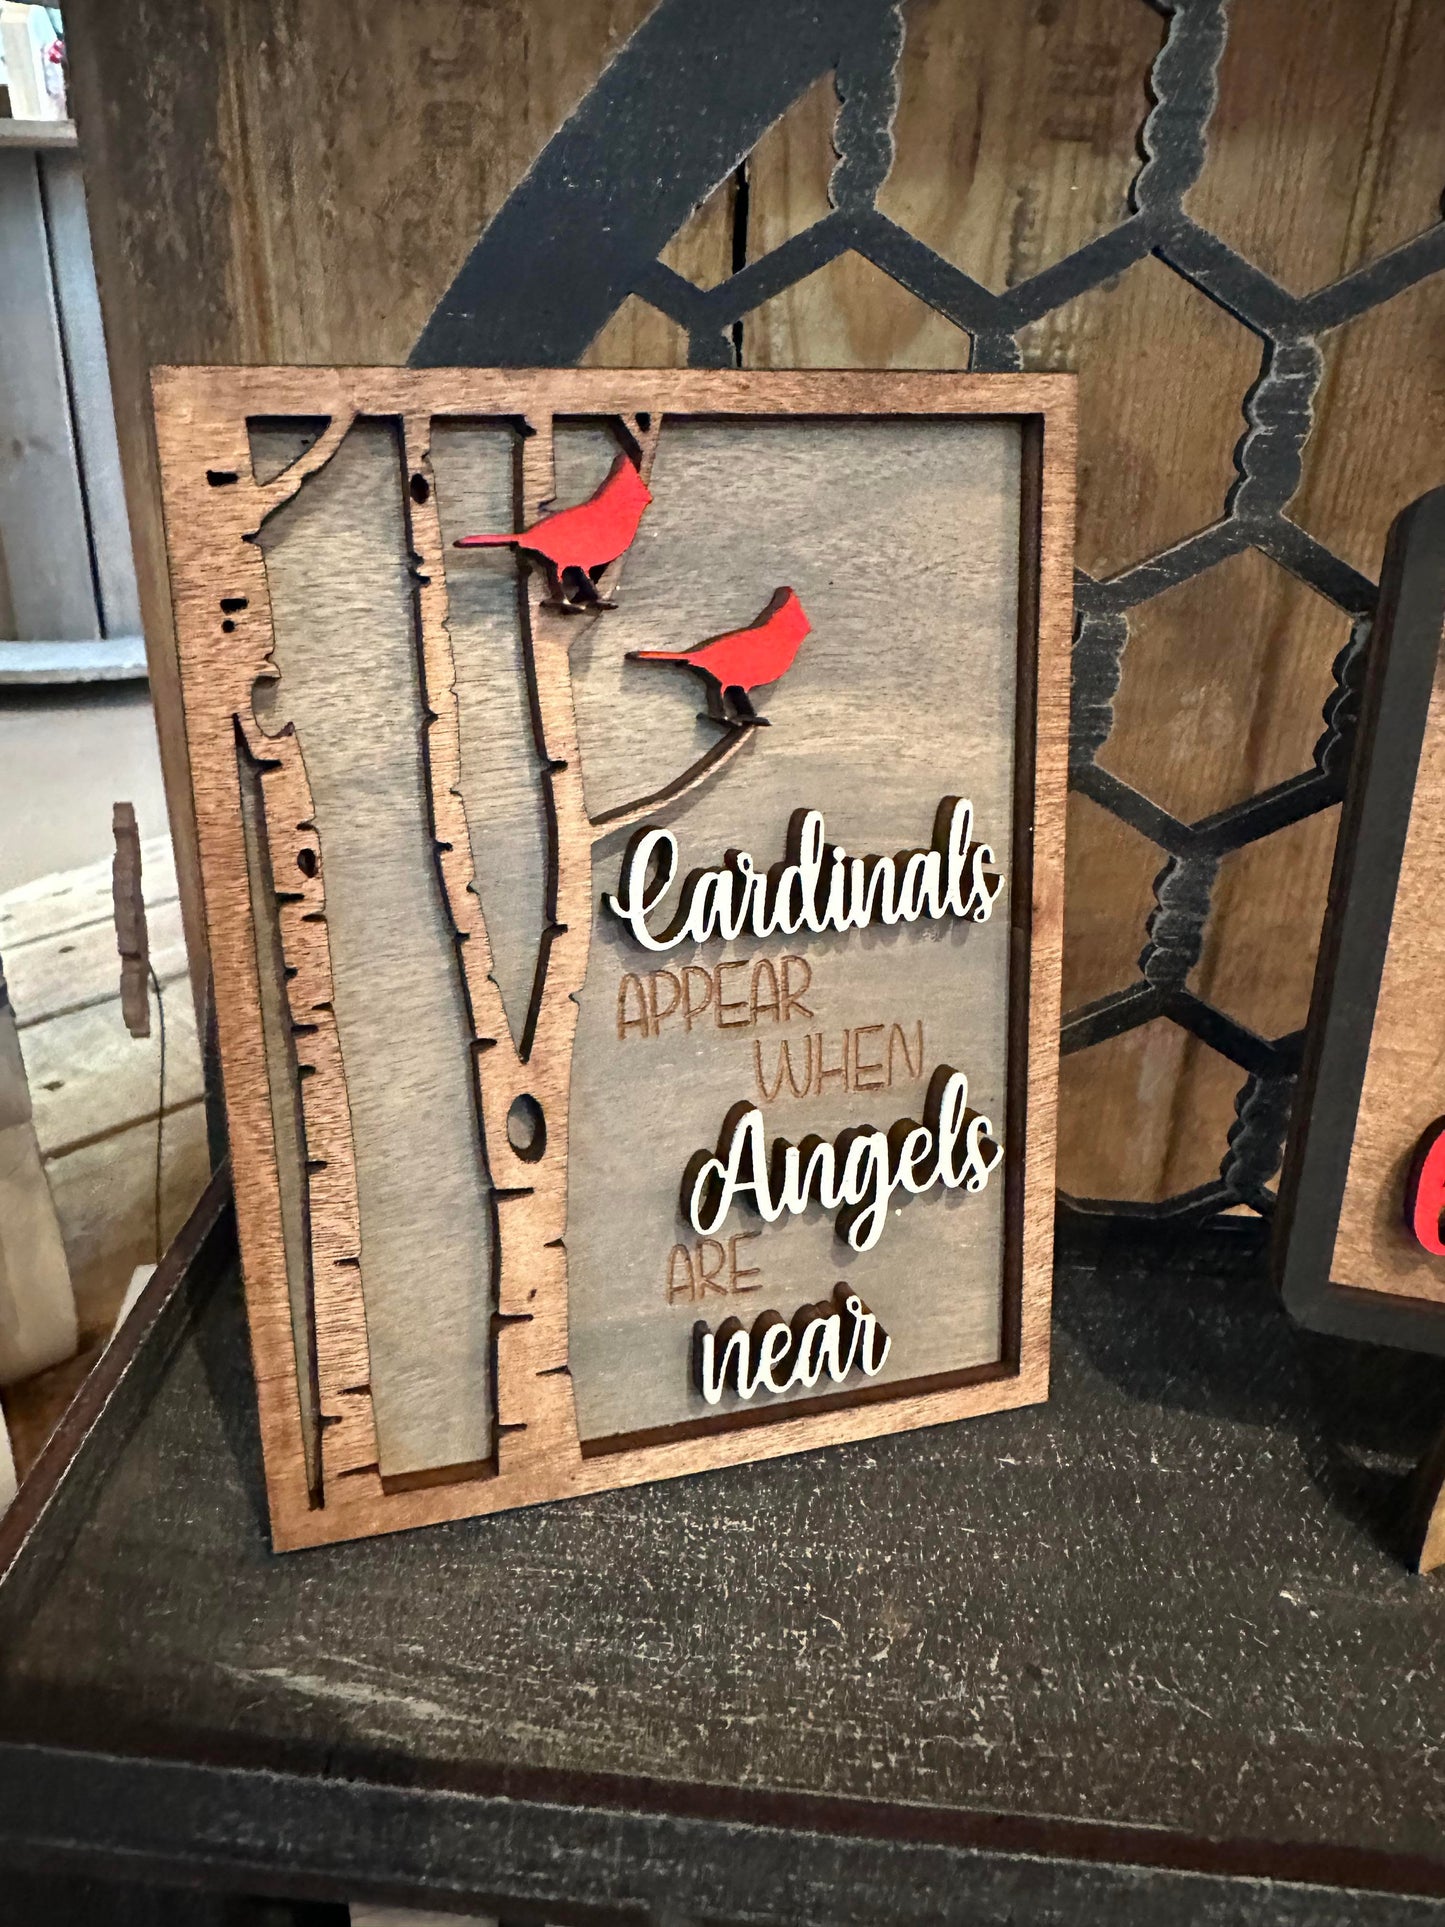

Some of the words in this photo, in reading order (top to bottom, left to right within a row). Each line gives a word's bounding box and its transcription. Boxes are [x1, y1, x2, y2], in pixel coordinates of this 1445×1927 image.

[608, 798, 1005, 952] Cardinals
[616, 955, 814, 1040] APPEAR
[753, 1020, 924, 1100] WHEN
[688, 1070, 1004, 1252] Angels
[667, 1231, 762, 1305] ARE
[700, 1293, 891, 1404] near
